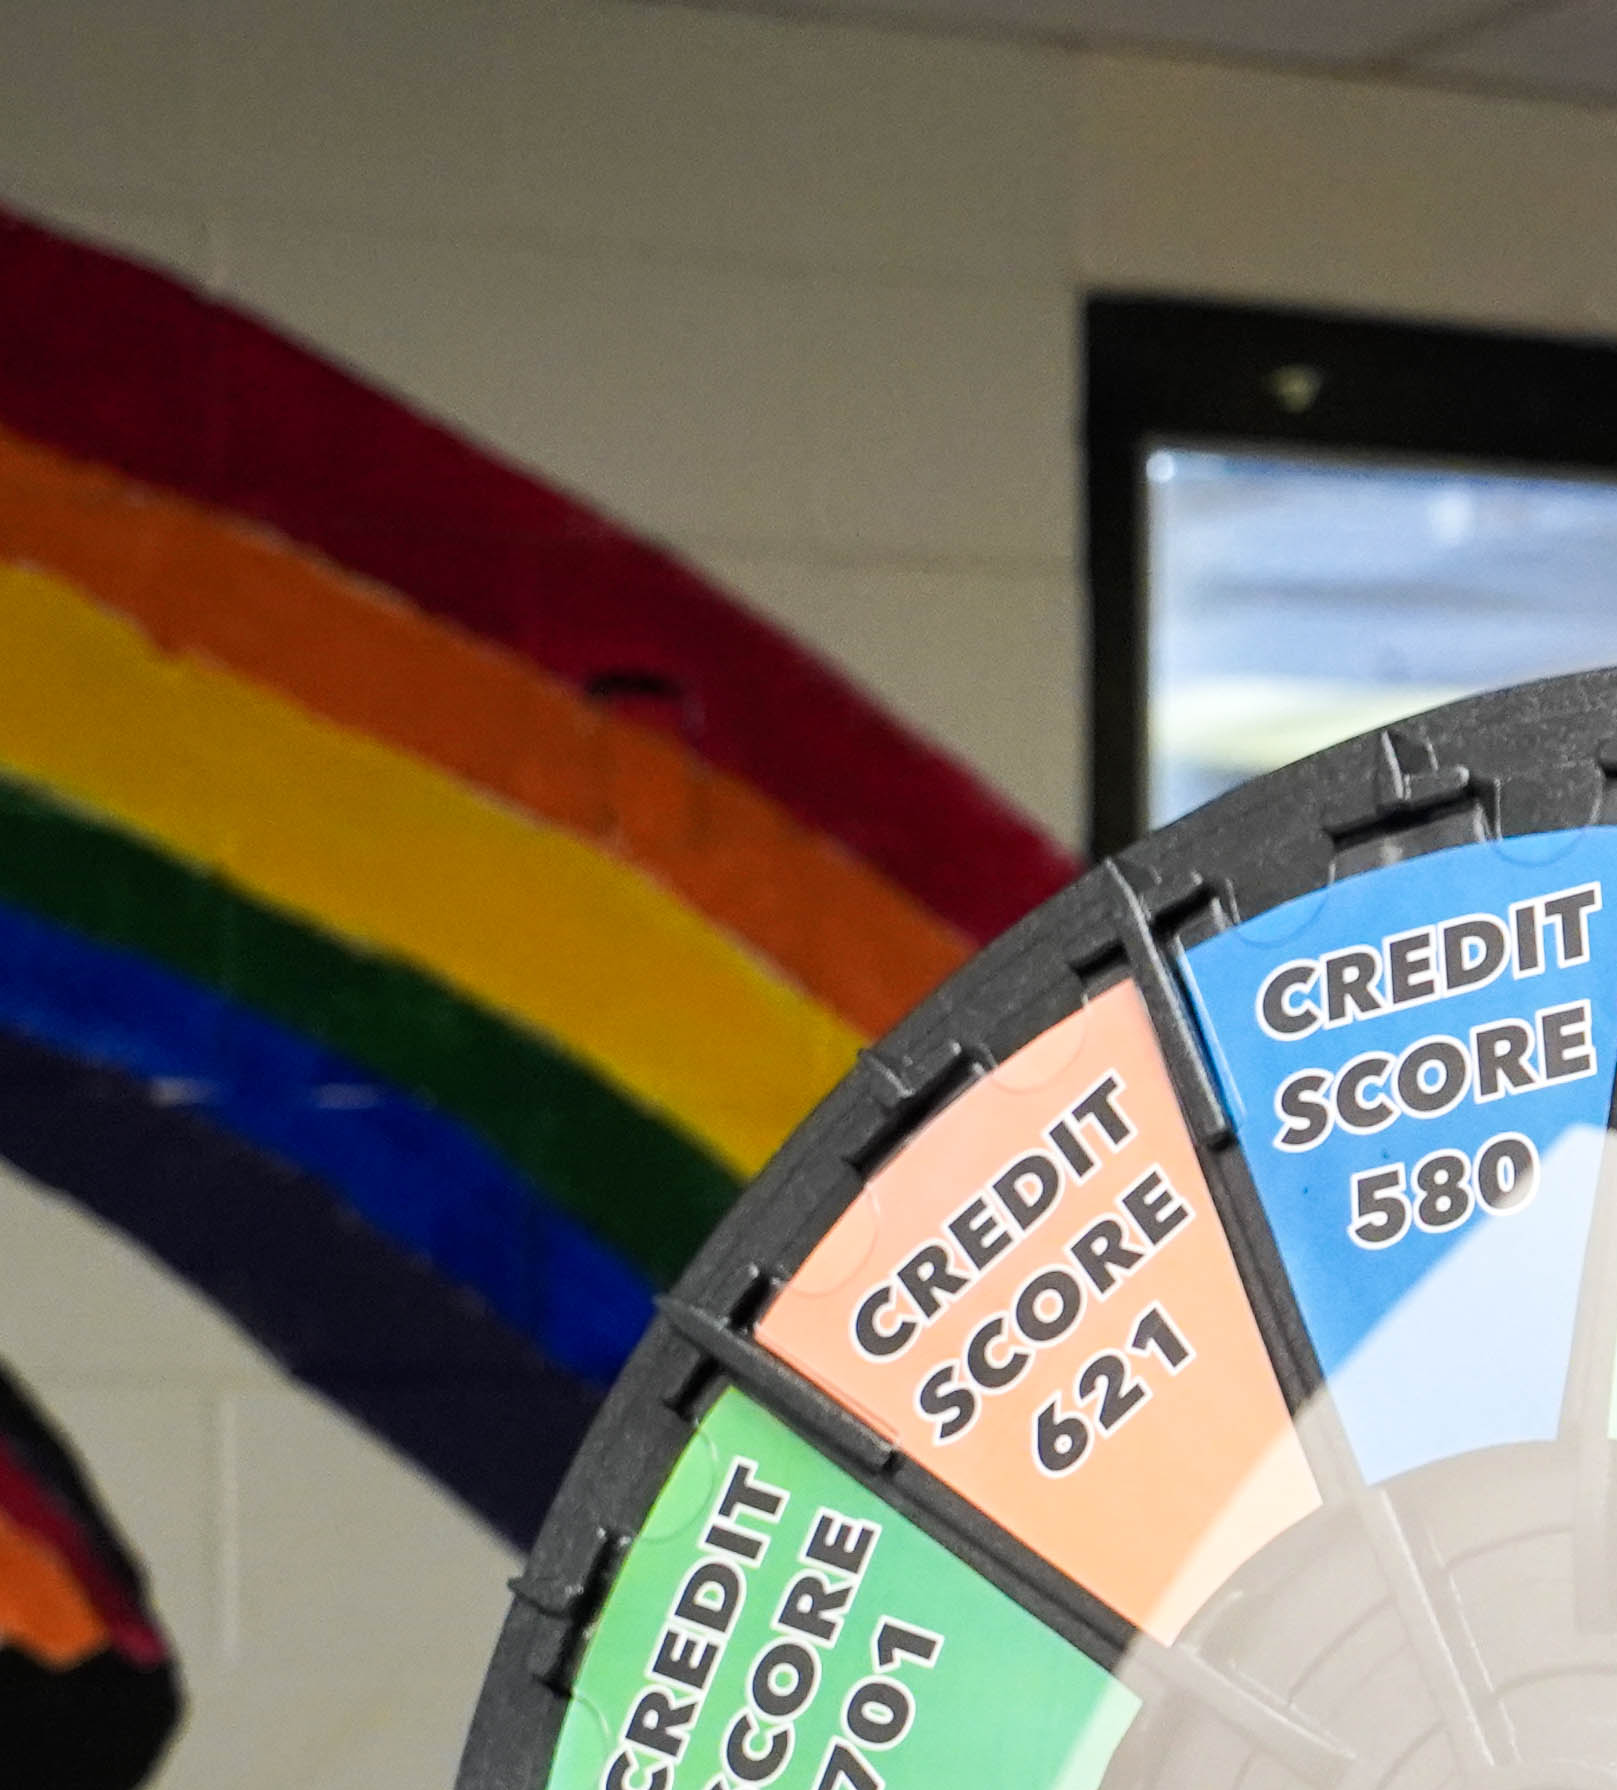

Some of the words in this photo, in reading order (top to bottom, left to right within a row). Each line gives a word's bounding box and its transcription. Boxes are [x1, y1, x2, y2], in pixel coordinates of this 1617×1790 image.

[1260, 884, 1598, 1039] CREDIT
[1276, 1002, 1594, 1148] SCORE
[854, 1072, 1138, 1357] CREDIT
[1352, 1137, 1535, 1245] 580
[919, 1170, 1191, 1441] SCORE
[1036, 1308, 1192, 1473] 621
